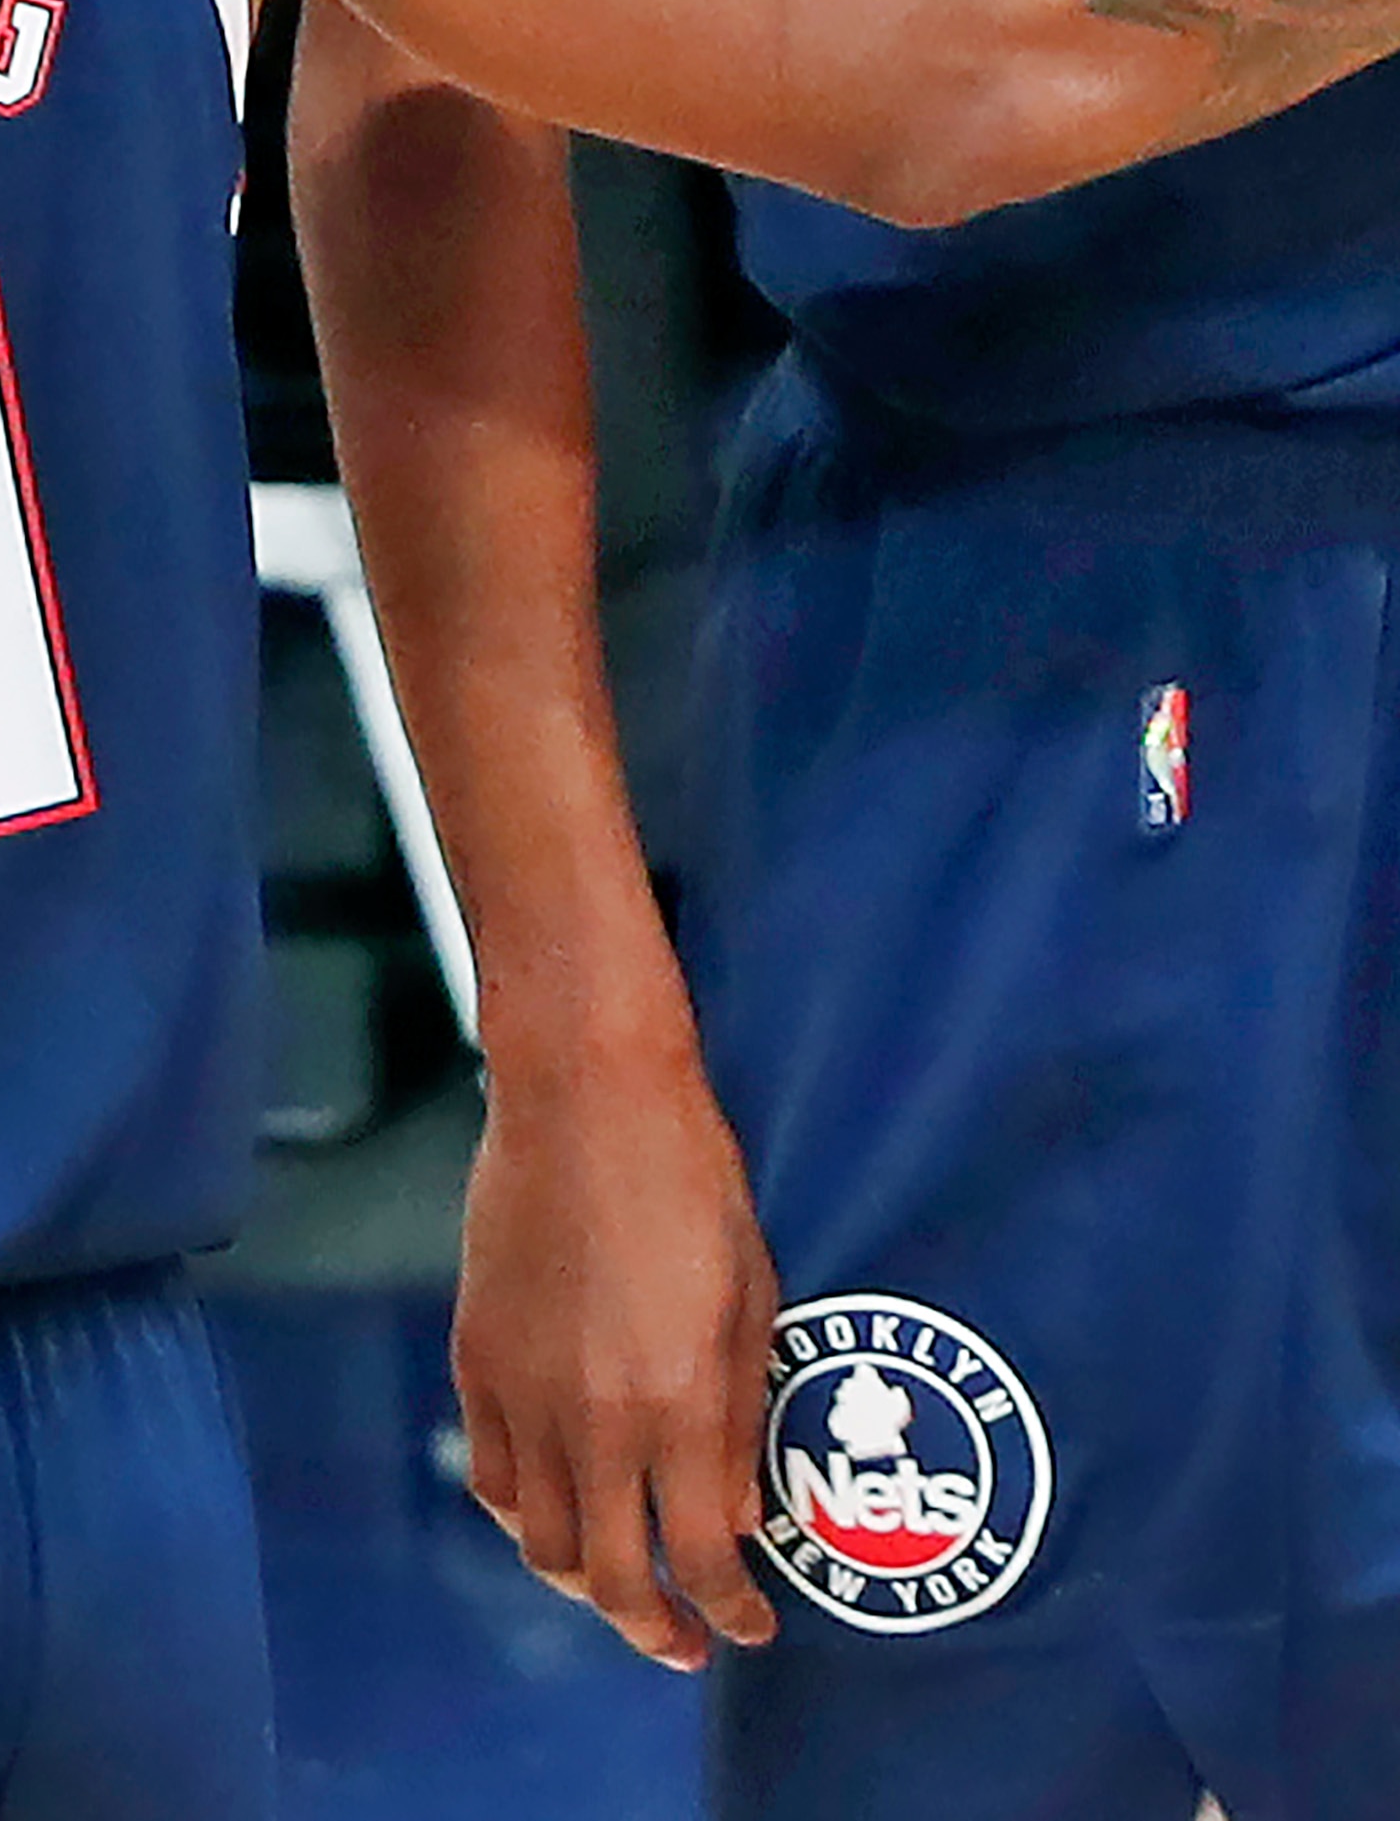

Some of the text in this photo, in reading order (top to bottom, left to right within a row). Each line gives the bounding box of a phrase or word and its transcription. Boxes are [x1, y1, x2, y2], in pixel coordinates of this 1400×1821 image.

[764, 1314, 1014, 1423] ROOKLYN
[784, 1445, 978, 1535] Nets
[764, 1513, 1014, 1614] NEW YORK
